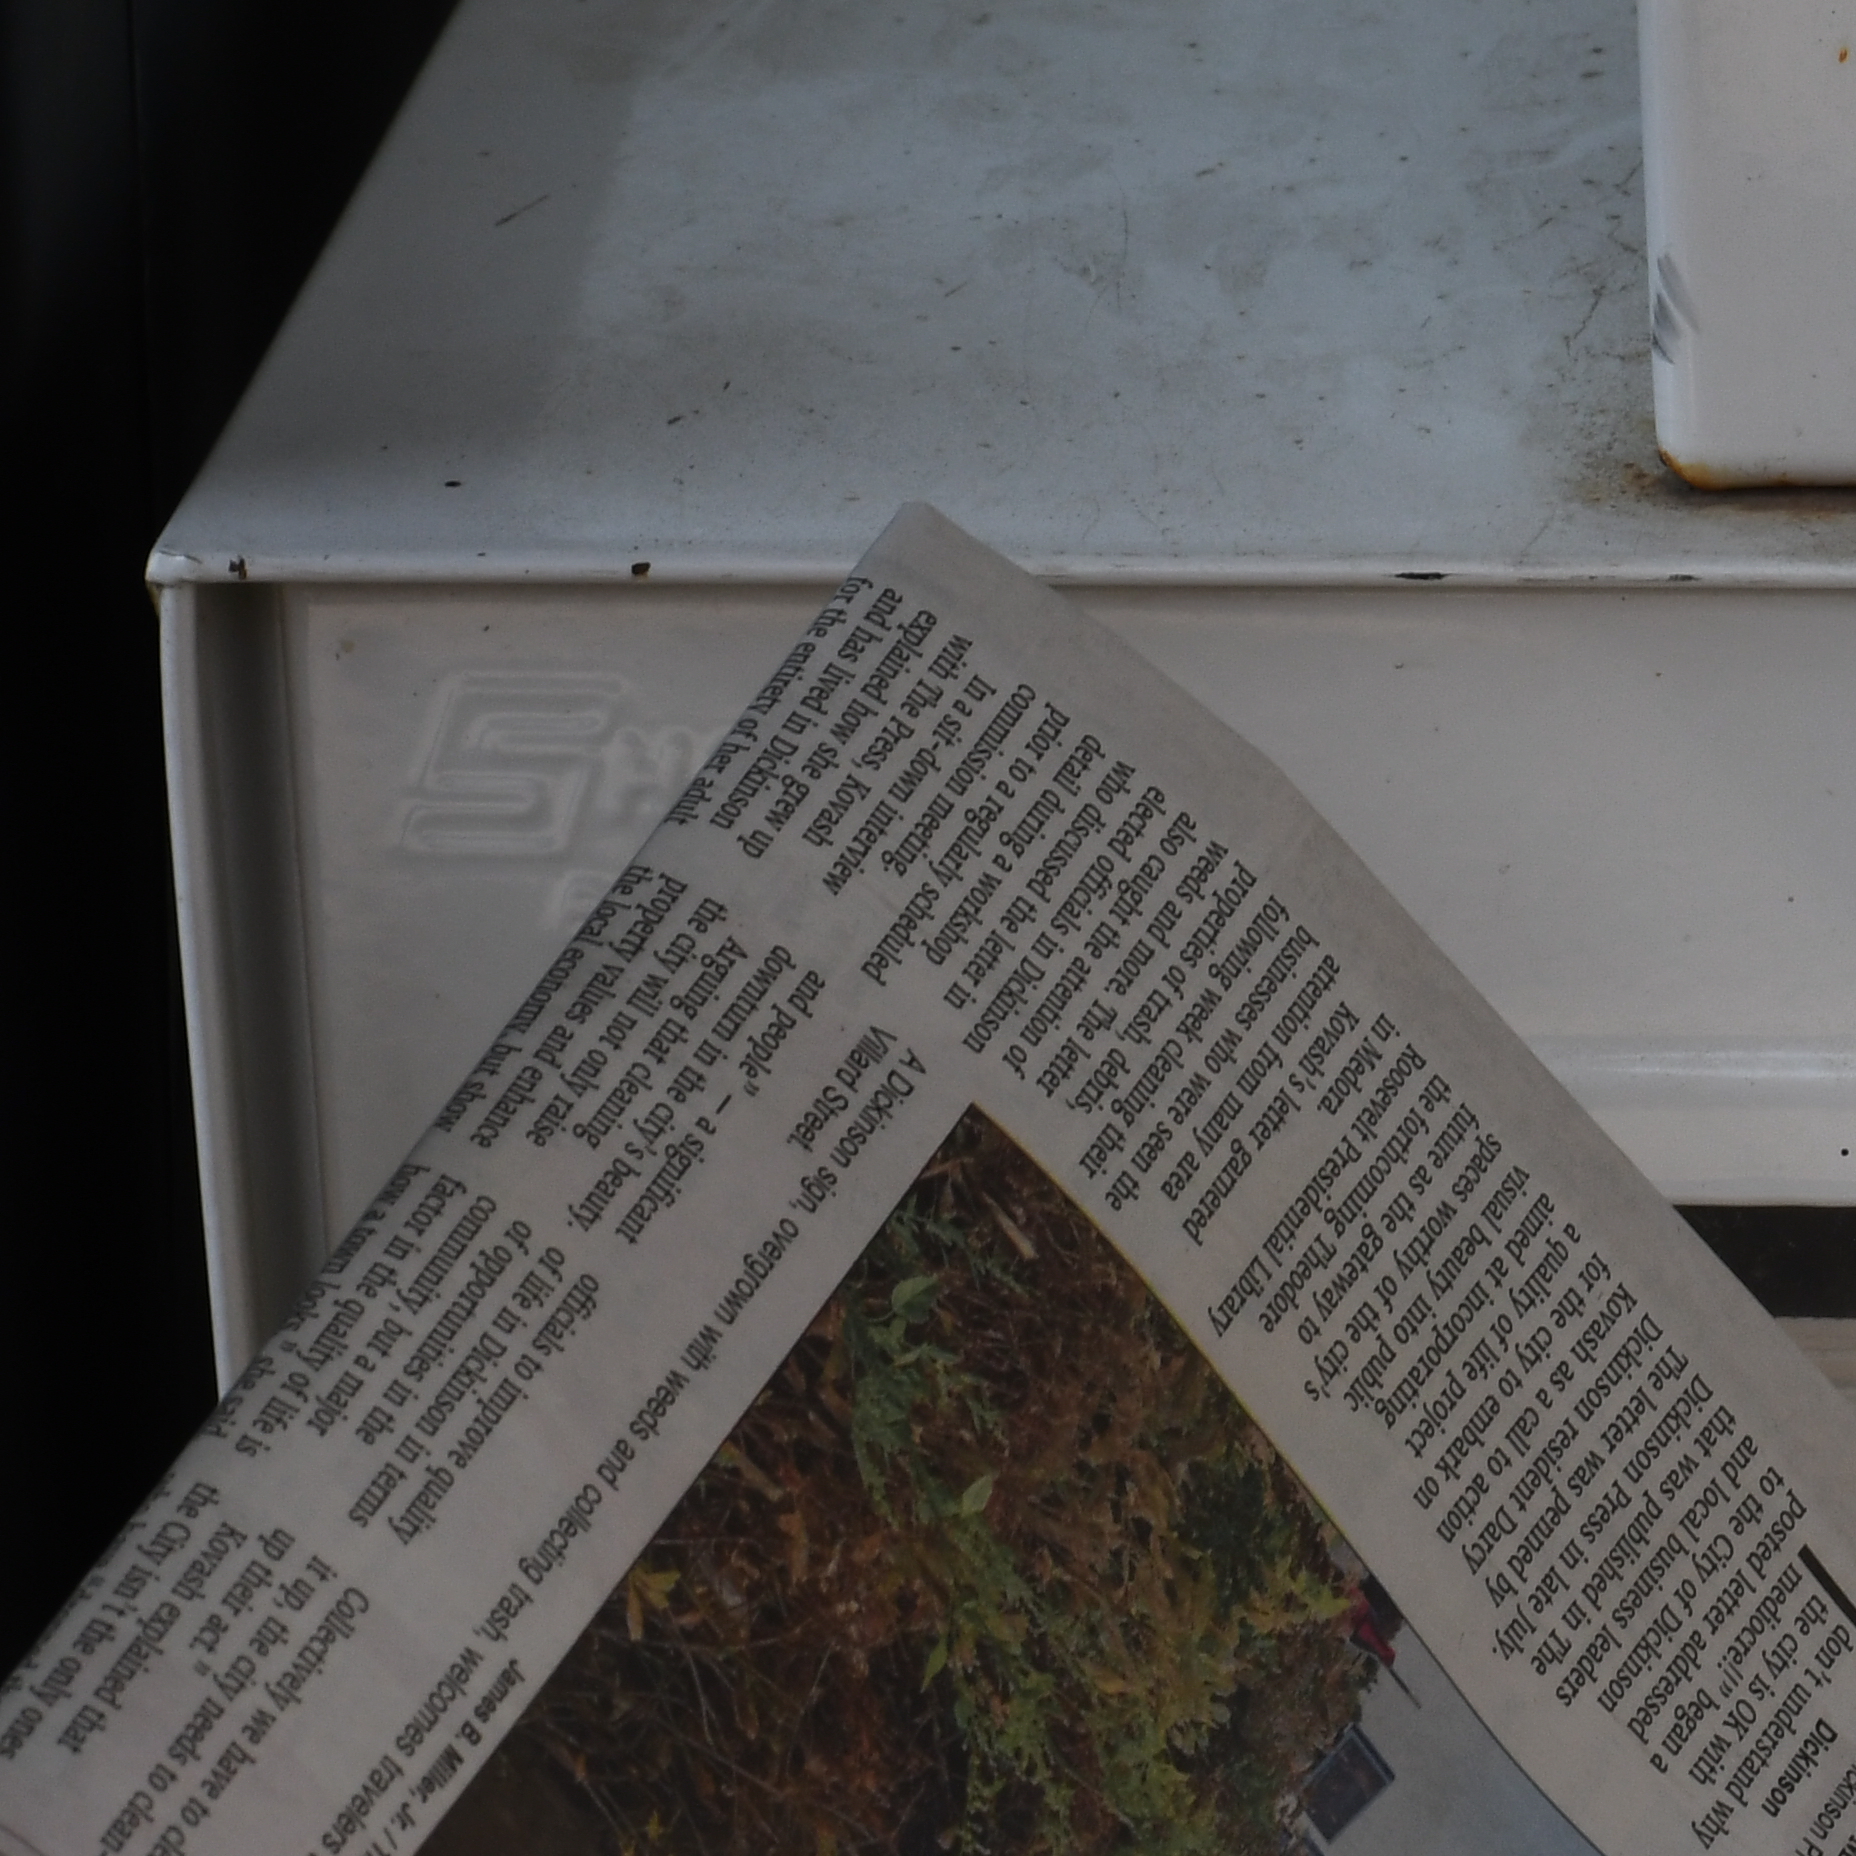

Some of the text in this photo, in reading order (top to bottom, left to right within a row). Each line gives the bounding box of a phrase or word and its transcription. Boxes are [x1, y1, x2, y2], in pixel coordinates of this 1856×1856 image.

[571, 934, 748, 1150] Arguing that cleaning
[897, 1046, 927, 1075] A
[1315, 1011, 1401, 1116] in Medora.
[785, 1024, 898, 1153] Villard Street.
[828, 1068, 915, 1169] Dickinson
[1246, 1085, 1302, 1152] letter
[787, 1165, 838, 1214] sign,
[1180, 1136, 1253, 1247] garnered
[1206, 1041, 1427, 1338] Roosevelt Presidential Library
[712, 1216, 799, 1326] overgrown
[679, 1323, 723, 1372] with
[628, 1368, 690, 1441] weeds
[594, 1437, 636, 1492] and
[517, 1482, 603, 1586] collecting
[55, 1520, 248, 1755] Kovash explained that
[263, 1586, 370, 1712] Collectively
[472, 1581, 534, 1642] trash,
[1625, 1487, 1807, 1746] posted letter addressed
[240, 1707, 278, 1745] we
[394, 1645, 484, 1758] welcomes
[454, 1719, 483, 1747] B.
[472, 1657, 526, 1724] James
[199, 1739, 257, 1801] have
[407, 1742, 465, 1804] Miller,
[1723, 1681, 1812, 1808] understand
[1760, 1716, 1838, 1818] Dickinson
[179, 1795, 211, 1828] to
[320, 1753, 405, 1856] travelers
[389, 1800, 416, 1831] Jr.
[1690, 1798, 1735, 1850] why
